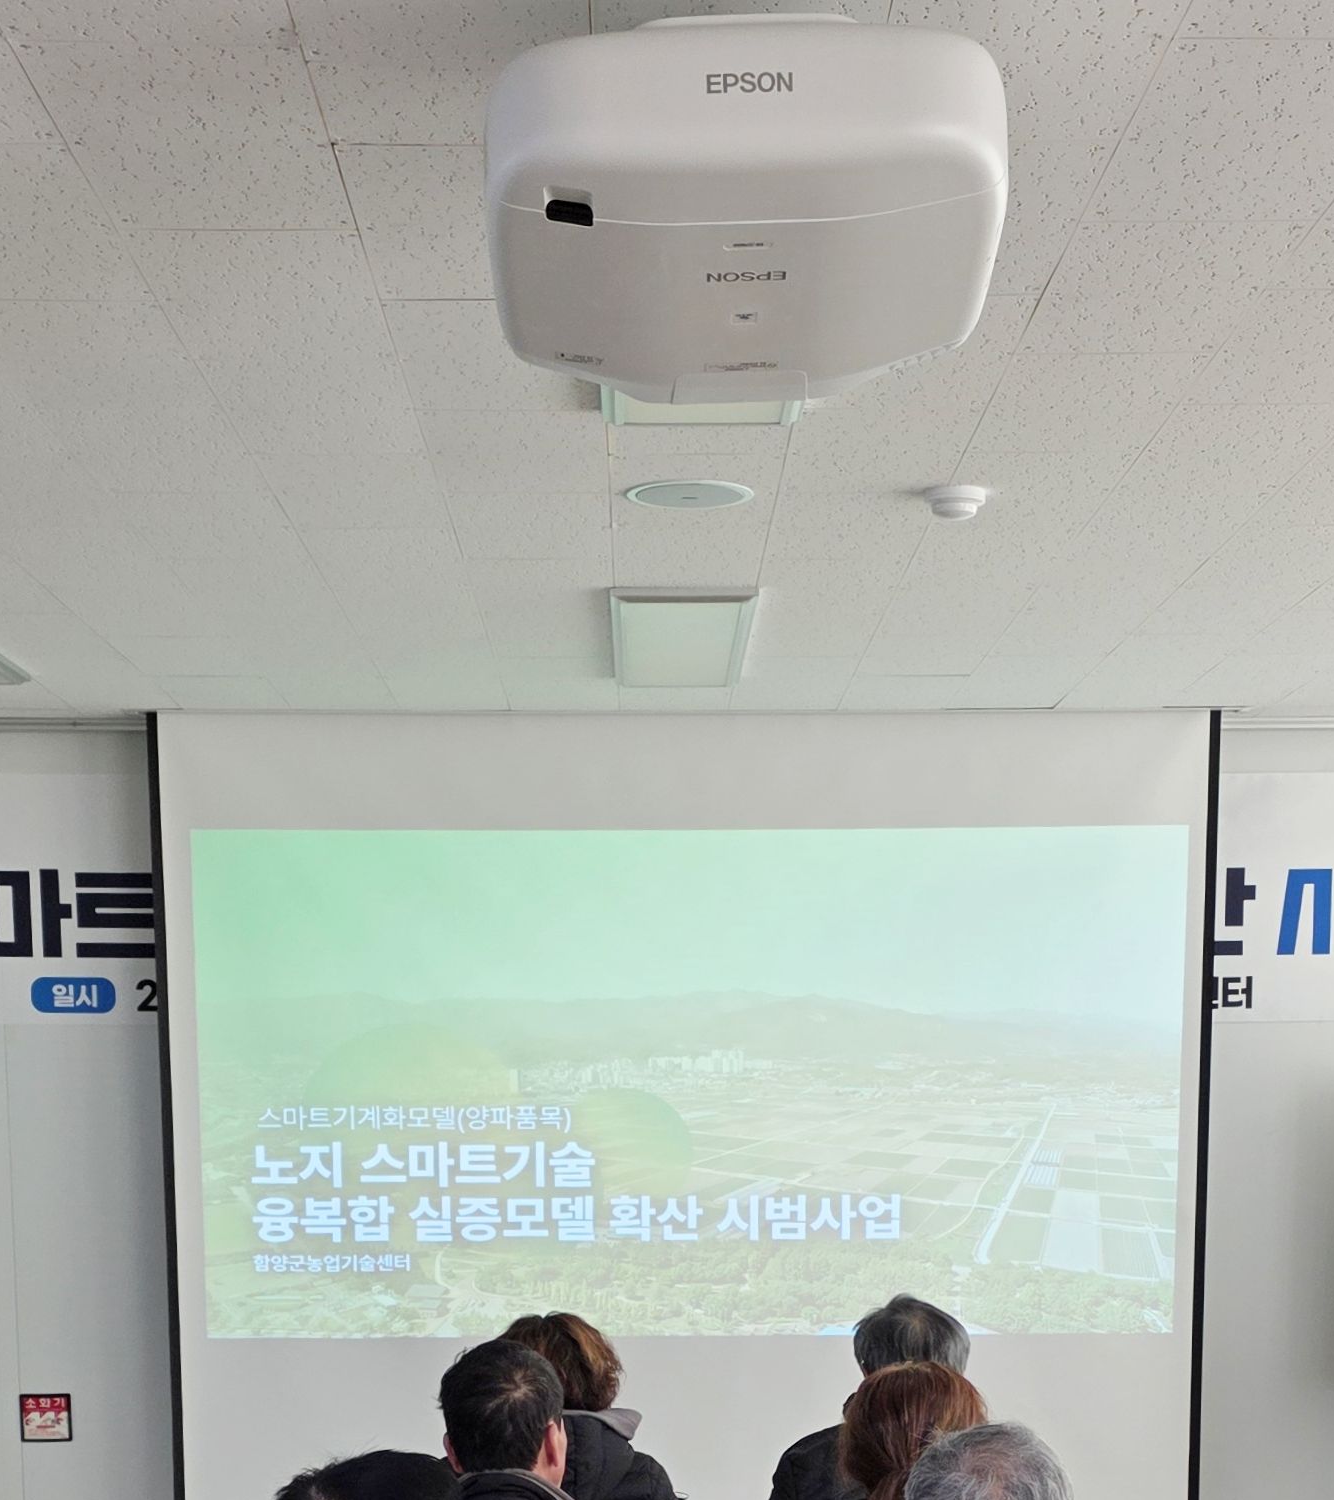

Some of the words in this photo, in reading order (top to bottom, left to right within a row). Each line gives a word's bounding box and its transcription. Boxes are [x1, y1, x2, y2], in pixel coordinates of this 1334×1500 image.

[706, 72, 794, 94] EPSON
[706, 271, 787, 283] EPSON
[52, 984, 98, 1008] 일시
[1213, 976, 1253, 1009] 터
[256, 1105, 572, 1133] 스마트기계화모델(양파품목)
[251, 1141, 343, 1188] 노지
[360, 1140, 595, 1188] 스마트기술
[252, 1196, 395, 1243] 융복합
[409, 1195, 596, 1242] 실증모델
[609, 1195, 703, 1241] 확산
[716, 1194, 902, 1241] 시범사업
[252, 1253, 411, 1273] 함양군농업기술센터
[25, 1397, 66, 1409] 소화기
